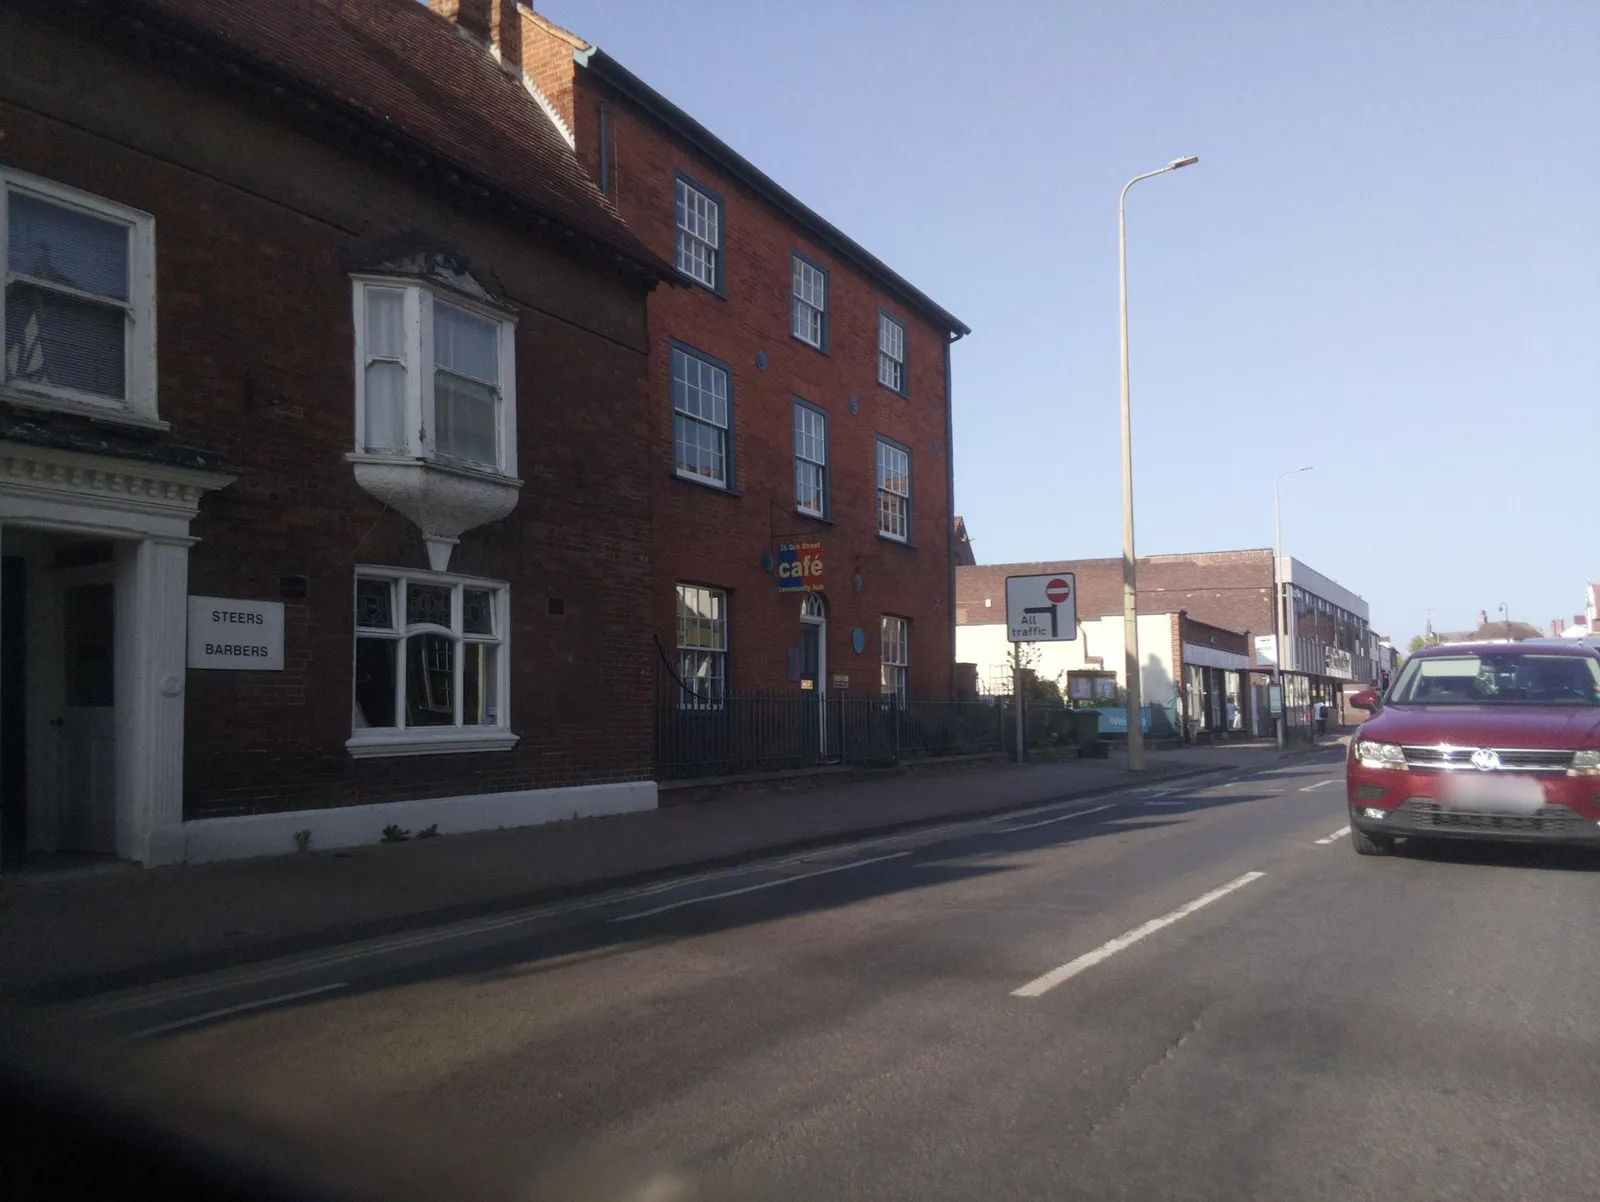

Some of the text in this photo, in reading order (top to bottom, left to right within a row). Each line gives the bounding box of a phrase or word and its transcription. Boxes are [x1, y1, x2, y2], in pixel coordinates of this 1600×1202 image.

[779, 554, 823, 578] café
[212, 610, 264, 625] STEERS
[1021, 616, 1037, 624] All
[1011, 627, 1047, 636] traffic
[205, 644, 268, 657] BARBERS
